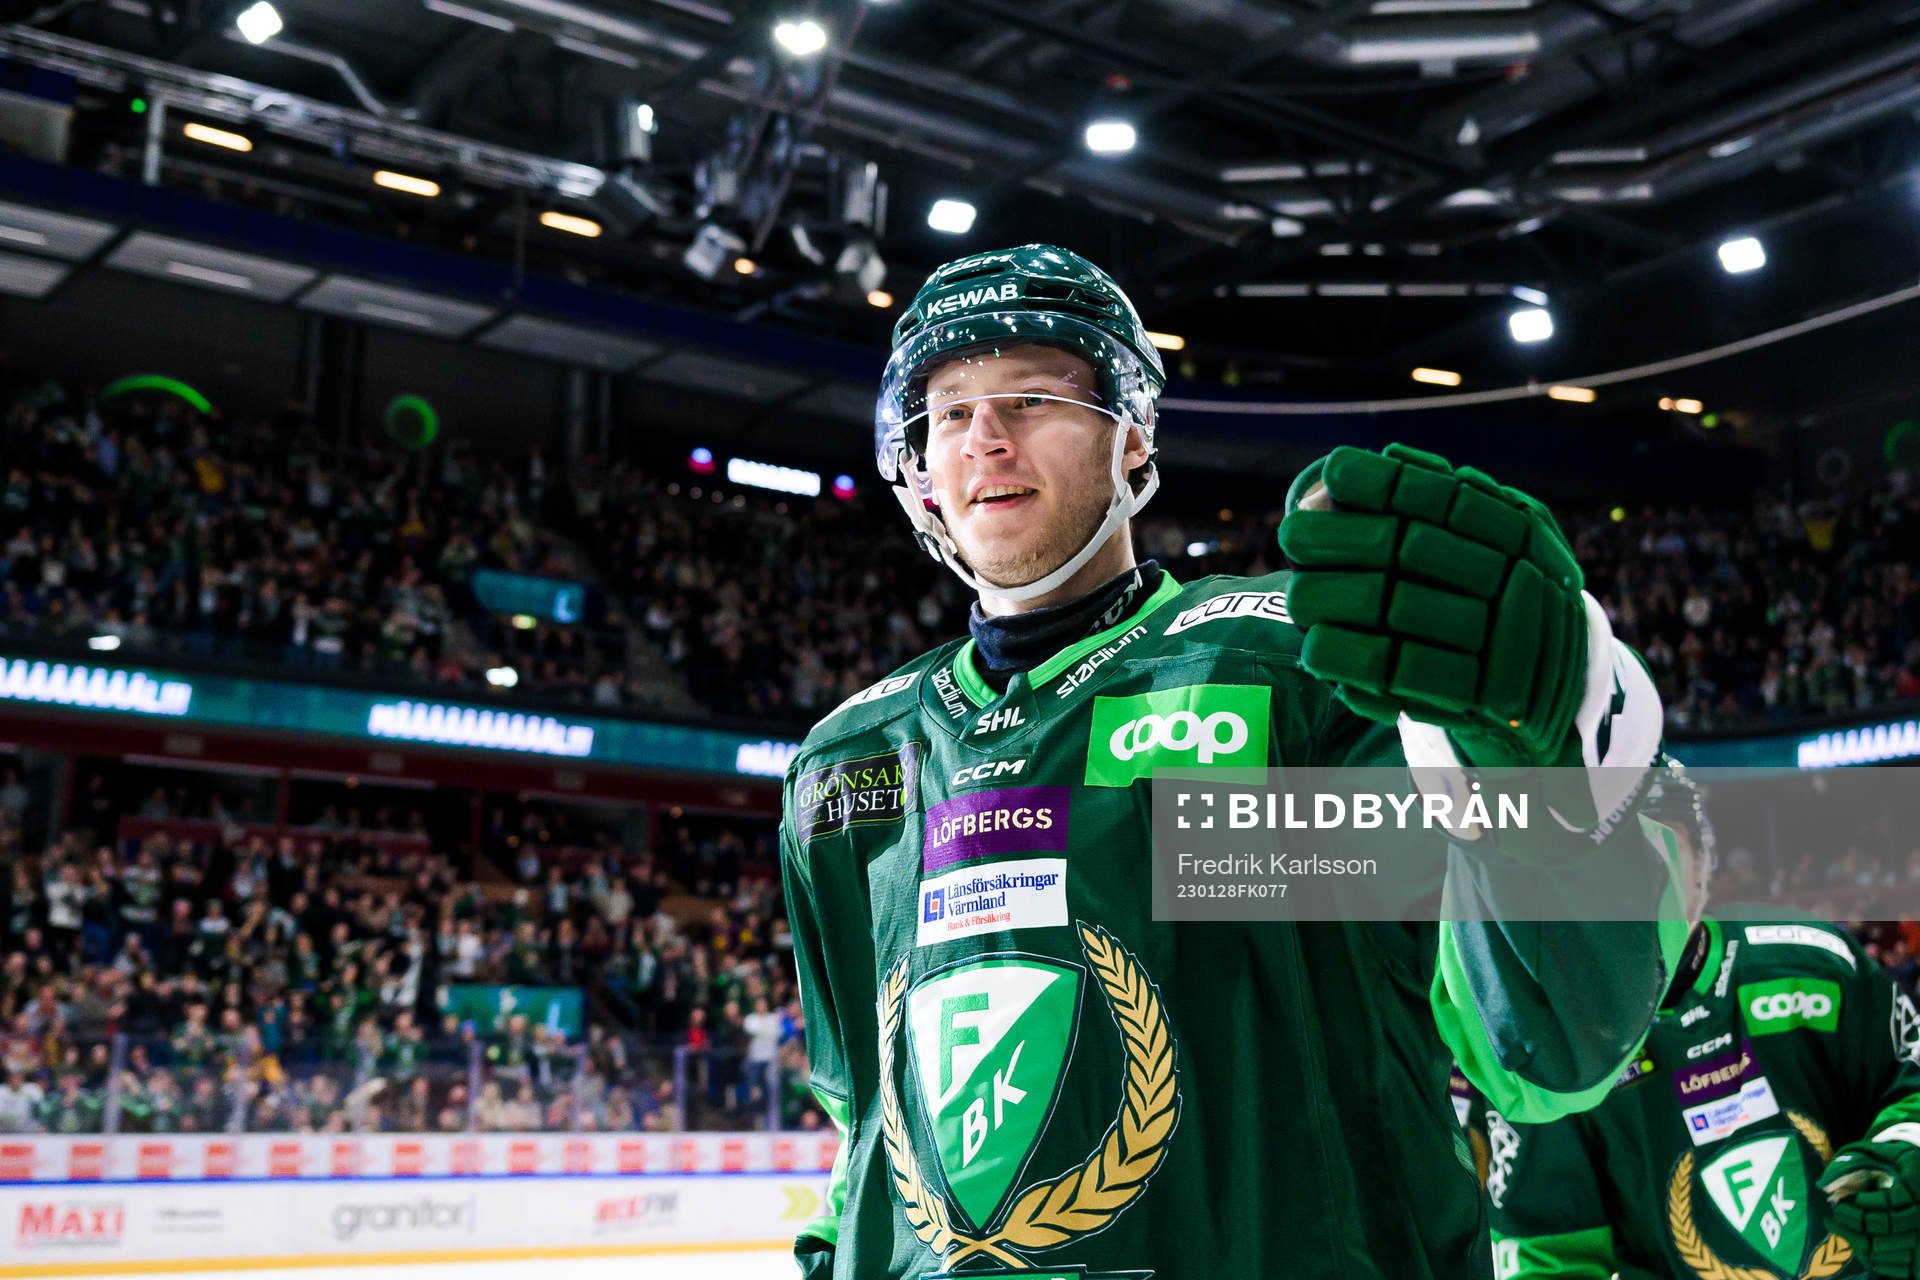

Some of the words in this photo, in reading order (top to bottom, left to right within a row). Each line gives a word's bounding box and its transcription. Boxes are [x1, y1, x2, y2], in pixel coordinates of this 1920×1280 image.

[927, 283, 1018, 319] KEWAB
[1056, 625, 1148, 700] stadium
[931, 667, 968, 720] stadium
[974, 706, 1026, 736] SHL
[1109, 711, 1249, 764] coop
[952, 759, 1027, 786] CCM
[826, 788, 905, 823] HUSET
[933, 808, 1053, 848] LÖFBERGS
[948, 873, 1059, 900] Länsförsäkringar
[947, 918, 964, 931] Bank
[965, 917, 970, 927] &
[971, 912, 1011, 927] Försäkring
[948, 892, 1006, 917] Värmland
[1687, 1033, 1732, 1059] CCM
[1680, 1052, 1751, 1094] LÖFBERS
